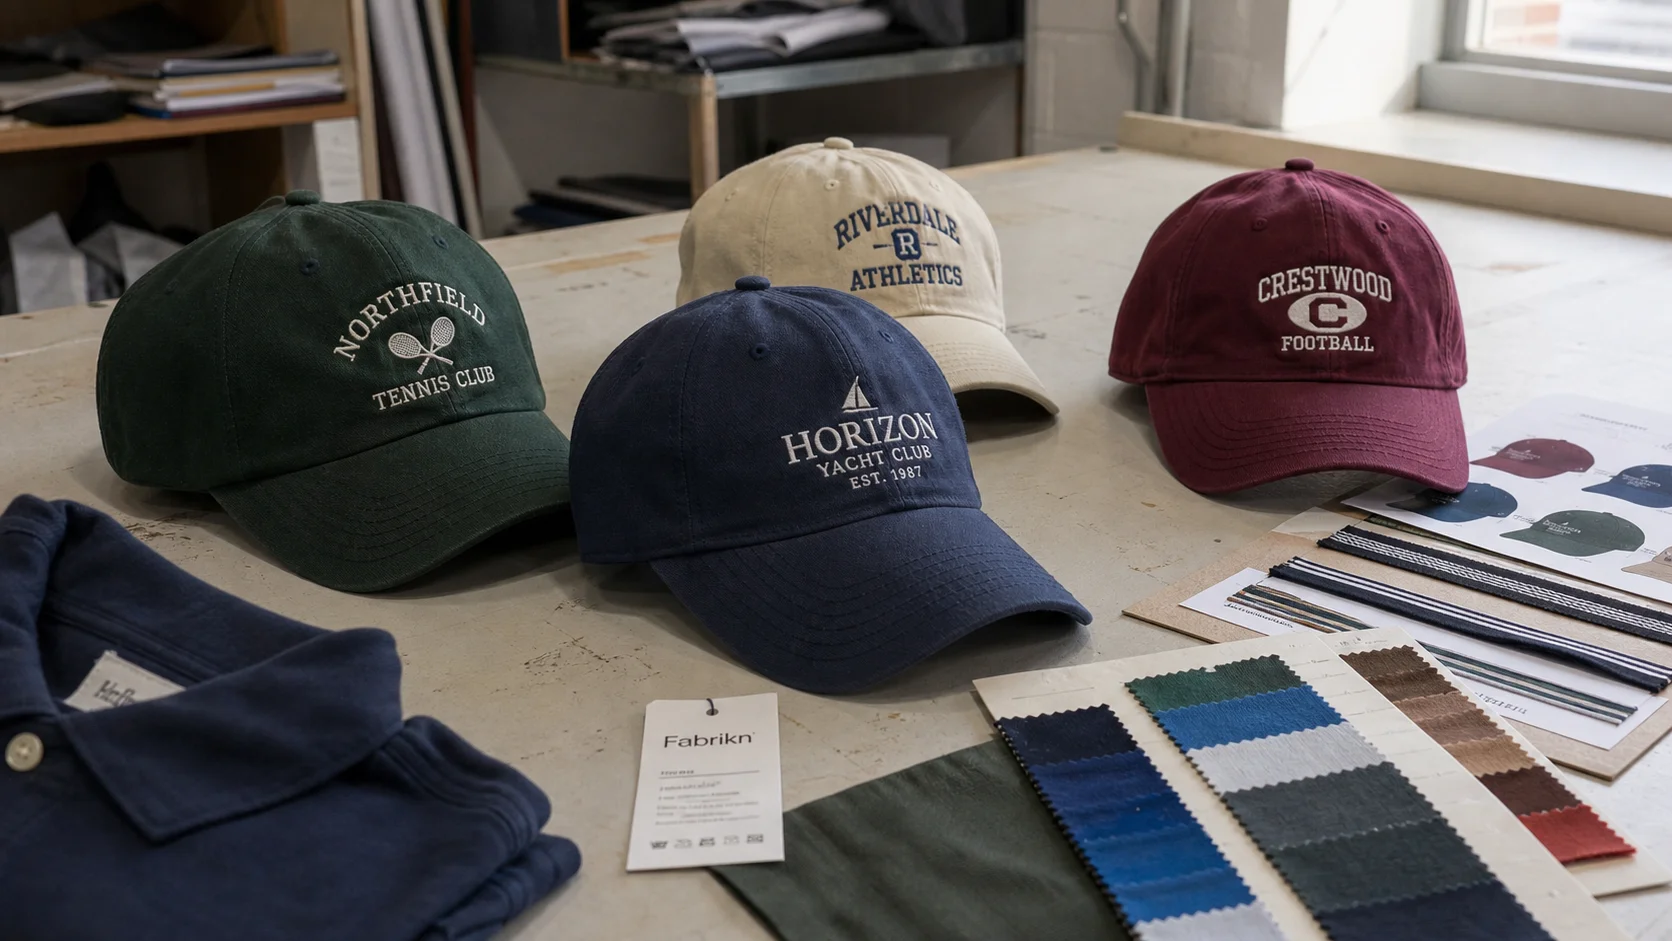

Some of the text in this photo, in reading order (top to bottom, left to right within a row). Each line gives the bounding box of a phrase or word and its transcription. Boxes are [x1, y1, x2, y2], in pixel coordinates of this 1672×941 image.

[833, 201, 961, 251] RIVERDALE
[895, 231, 919, 257] R
[850, 263, 963, 292] ATHLETICS
[1258, 265, 1392, 303] CRESTWOOD
[333, 281, 487, 362] NORTHFIELD
[1308, 297, 1348, 329] C
[1281, 335, 1375, 352] FOOTBALL
[372, 365, 496, 411] TENNIS CLUB
[781, 412, 939, 465] HORIZON
[816, 444, 933, 478] YACHT CLUB
[849, 465, 922, 490] EST. 1987
